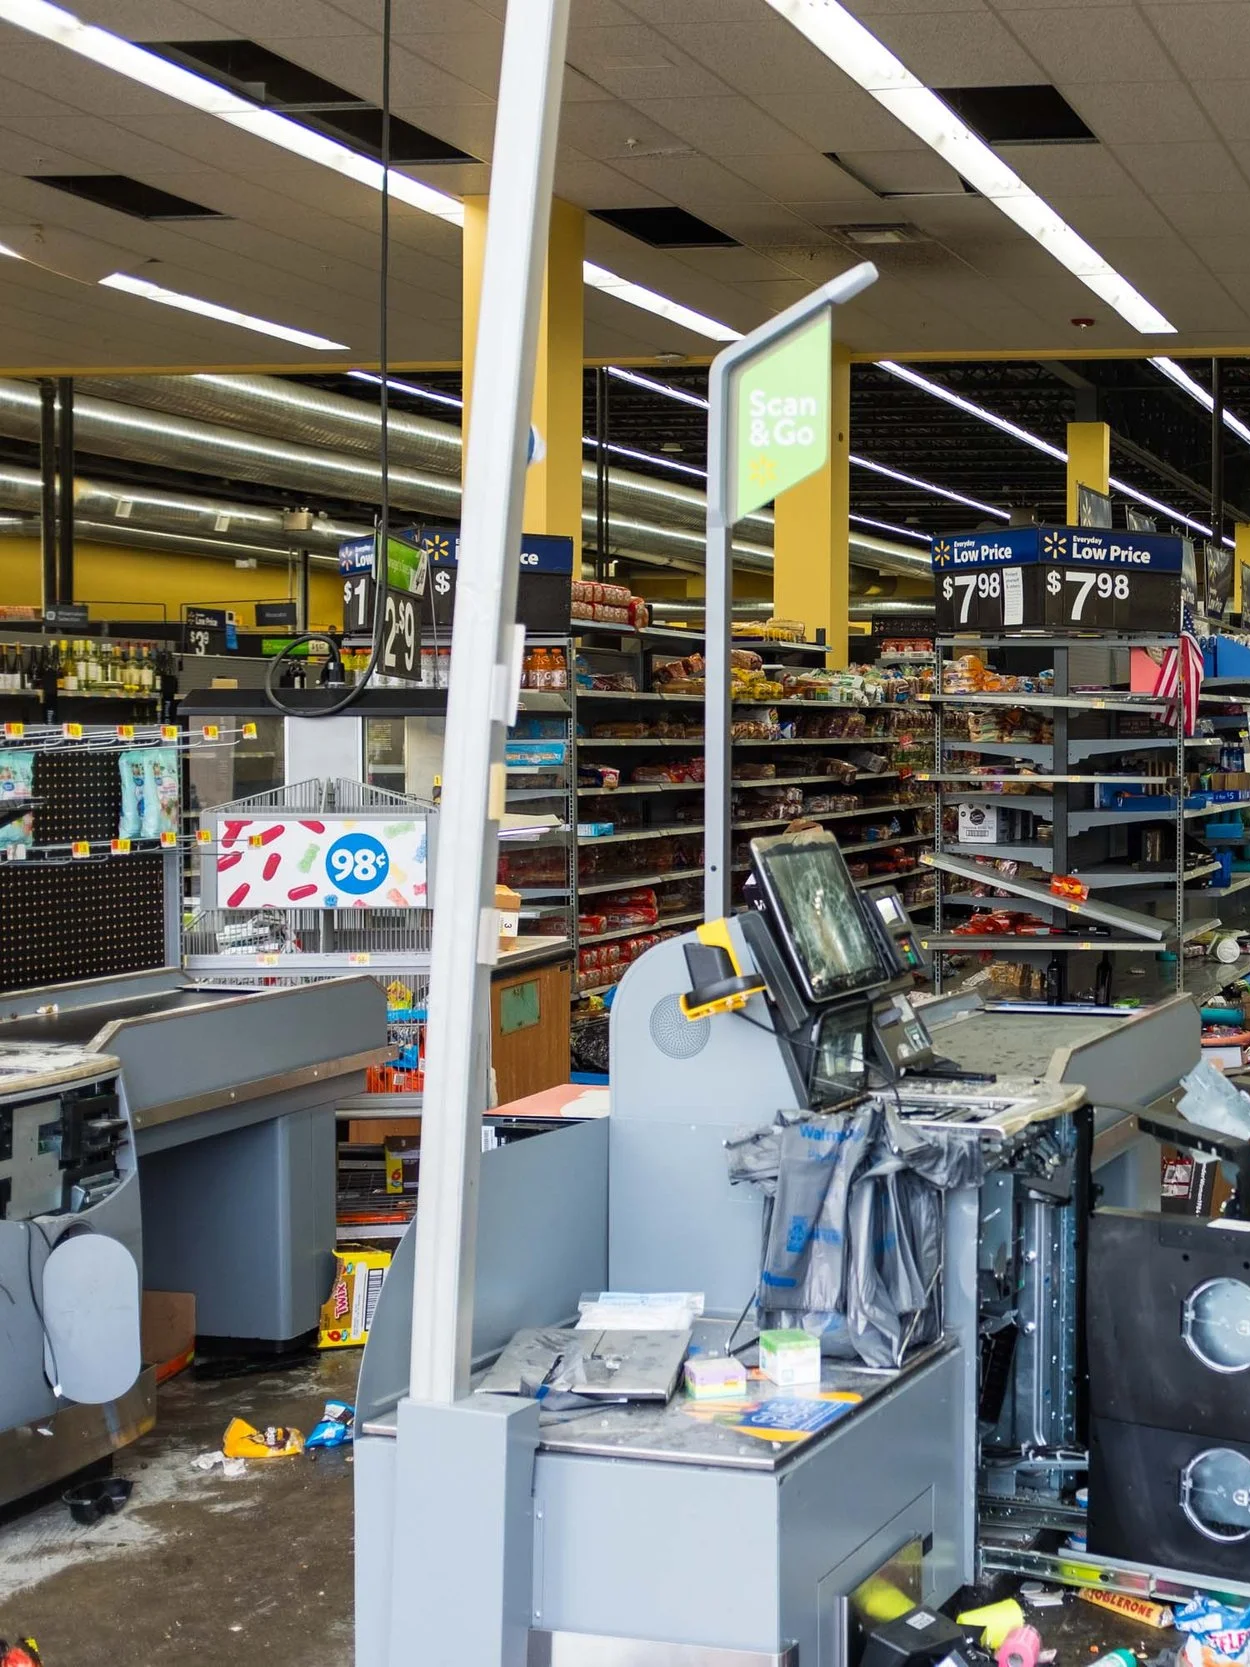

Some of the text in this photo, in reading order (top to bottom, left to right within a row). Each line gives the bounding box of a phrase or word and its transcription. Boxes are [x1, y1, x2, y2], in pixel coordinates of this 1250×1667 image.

[749, 389, 817, 417] Scan
[953, 540, 976, 548] Everyday
[1072, 535, 1103, 545] Everyday
[355, 553, 373, 567] Low
[953, 544, 1013, 564] Low Price
[1072, 544, 1151, 565] Low Price
[331, 848, 386, 882] 98¢
[800, 1124, 856, 1142] Walm
[335, 1281, 349, 1319] Twix
[327, 1329, 341, 1343] 6
[1089, 1589, 1154, 1619] TOBLERONE
